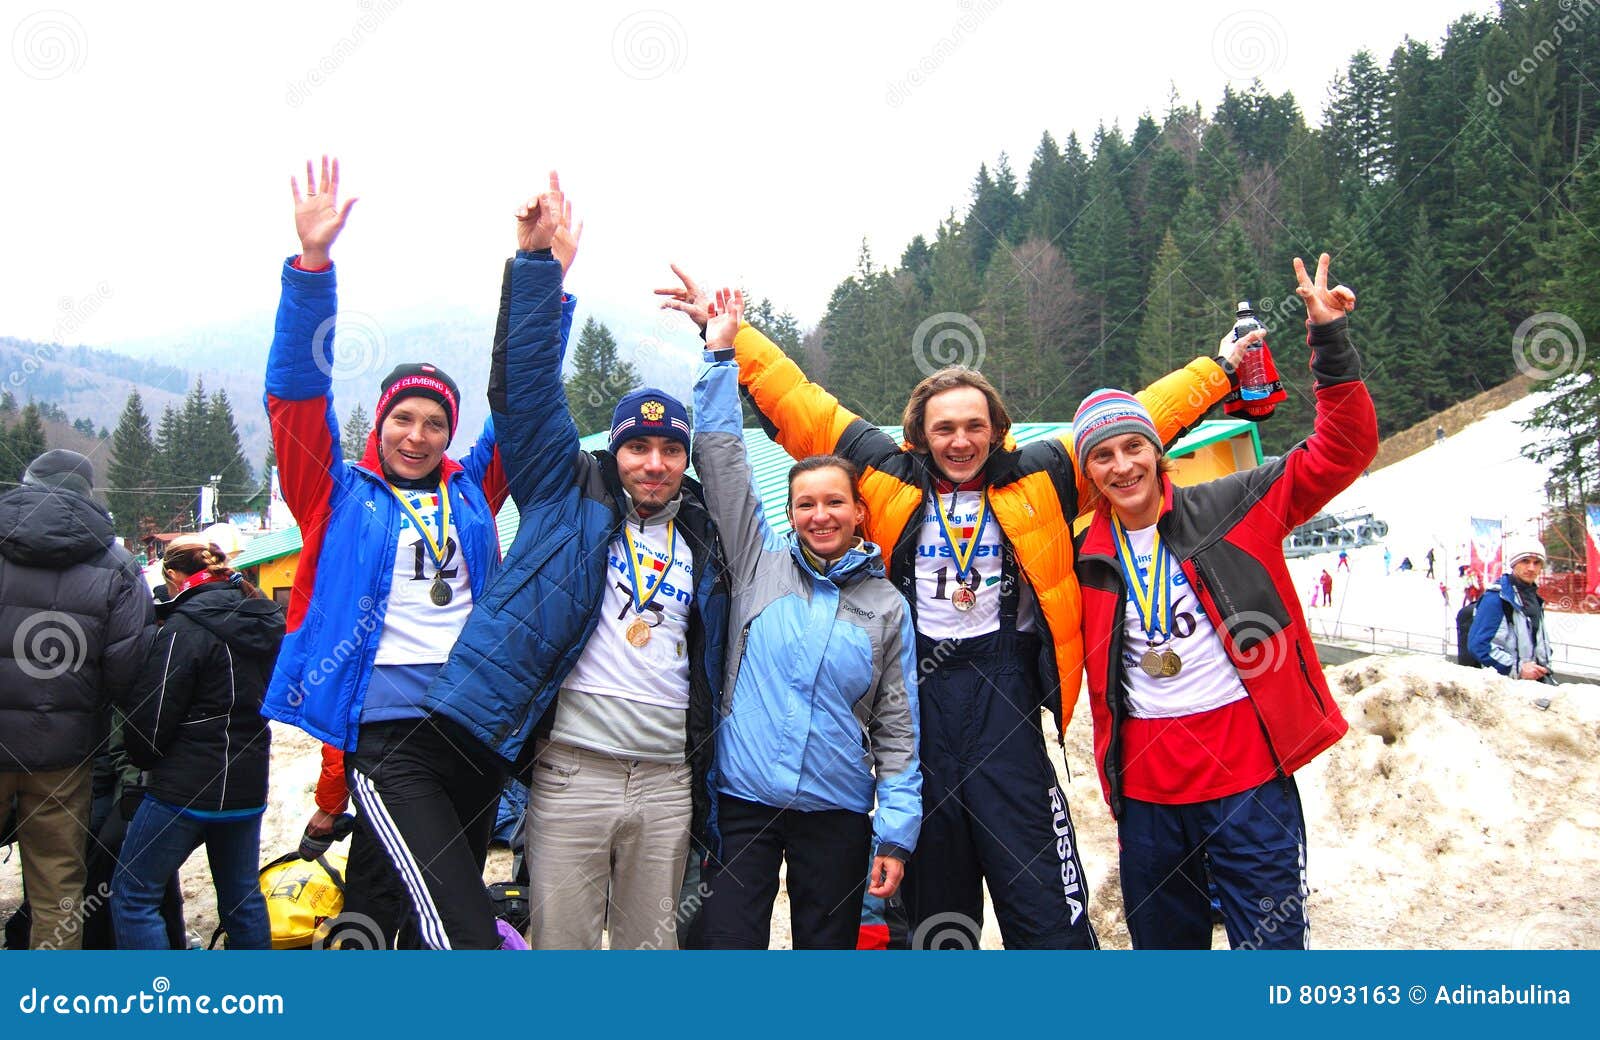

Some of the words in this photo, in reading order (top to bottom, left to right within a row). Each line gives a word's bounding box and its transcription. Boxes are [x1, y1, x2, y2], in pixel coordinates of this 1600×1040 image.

[408, 536, 459, 581] 12
[615, 581, 665, 628] 75
[1048, 786, 1083, 926] RUSSIA
